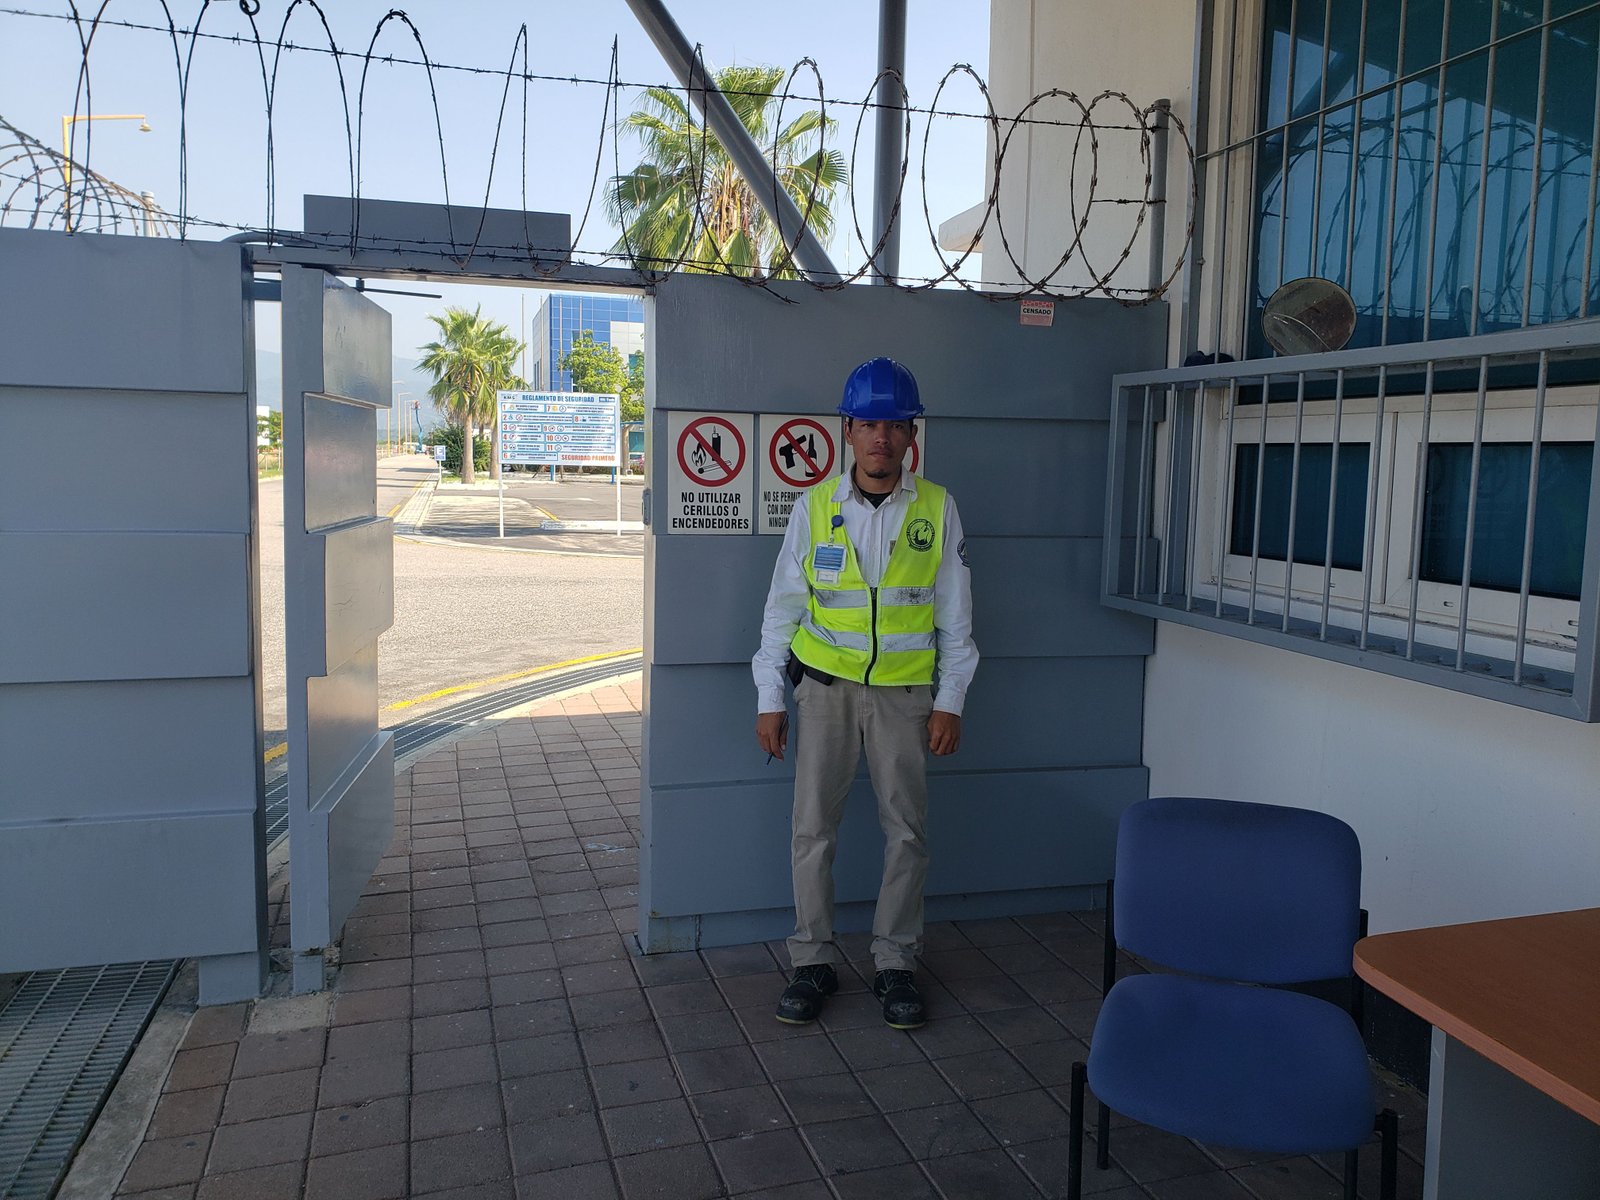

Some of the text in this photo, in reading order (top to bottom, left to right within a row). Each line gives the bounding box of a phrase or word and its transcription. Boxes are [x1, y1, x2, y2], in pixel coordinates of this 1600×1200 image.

[681, 492, 741, 504] NO UTILIZAR
[764, 491, 771, 502] NO
[772, 491, 779, 502] SE
[683, 505, 739, 516] CERILLOS O
[768, 504, 778, 515] CON
[672, 518, 749, 529] ENCENDEDORES
